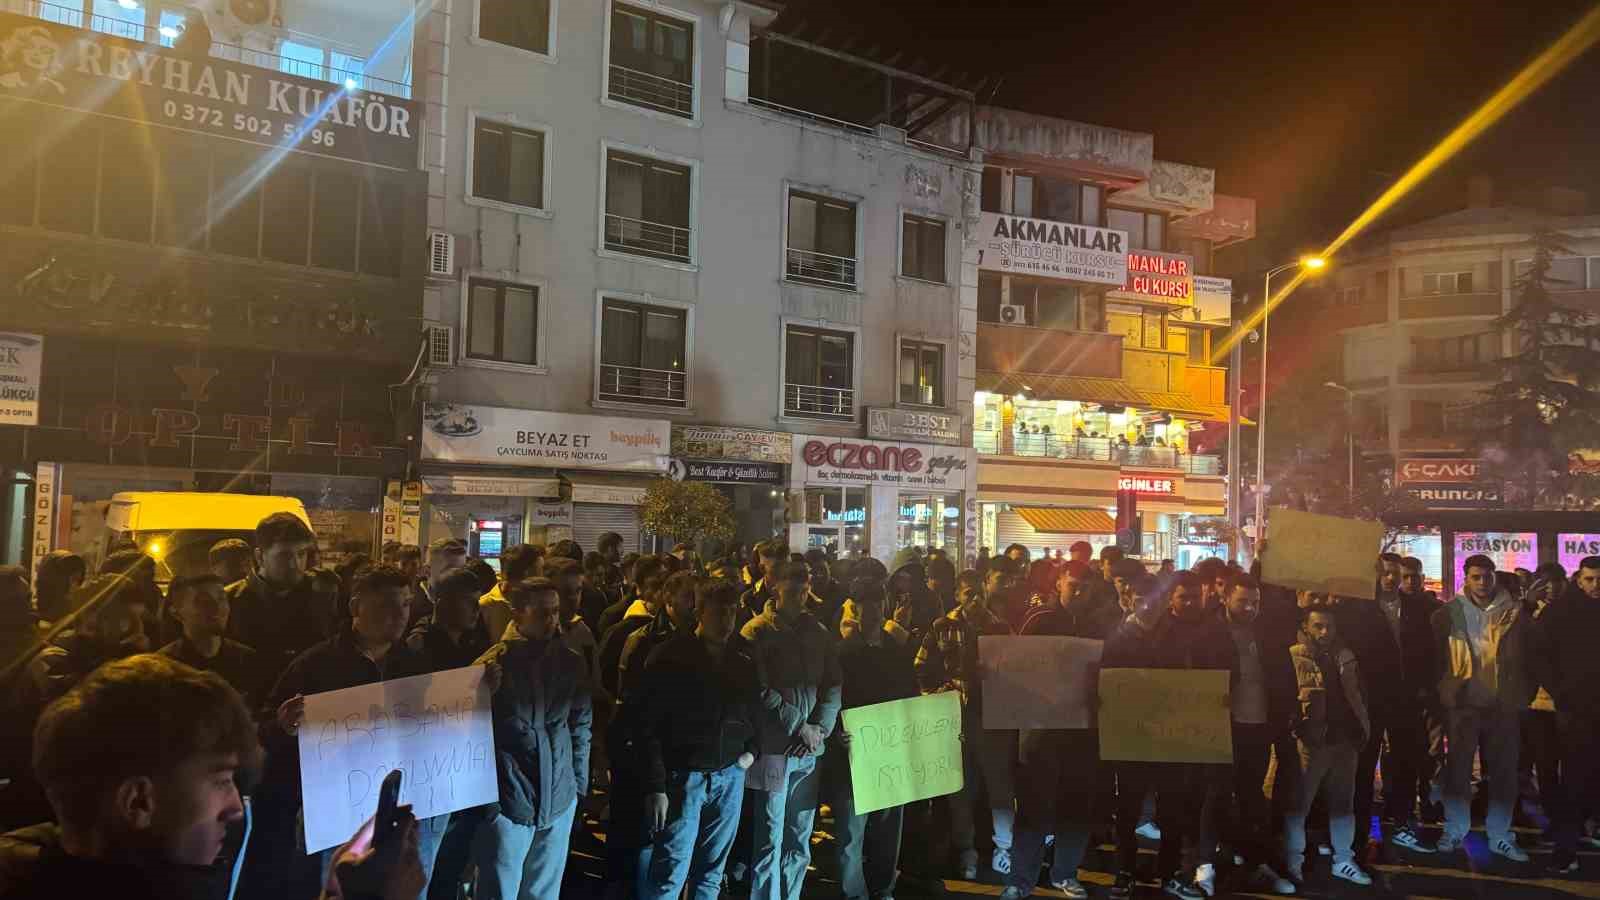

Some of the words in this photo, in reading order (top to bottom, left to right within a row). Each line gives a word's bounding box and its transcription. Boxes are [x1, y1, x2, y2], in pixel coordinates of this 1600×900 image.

[76, 39, 252, 106] REYHAN
[266, 79, 411, 138] KUAFÖR
[164, 100, 176, 117] 0
[182, 103, 224, 127] 372
[234, 113, 272, 137] 502
[311, 129, 335, 147] 96
[993, 217, 1122, 253] AKMANLAR
[1128, 254, 1187, 277] MANLAR
[1152, 278, 1190, 299] KURSU
[516, 430, 568, 447] BEYAZ
[573, 435, 591, 448] ET
[803, 440, 923, 473] eczane
